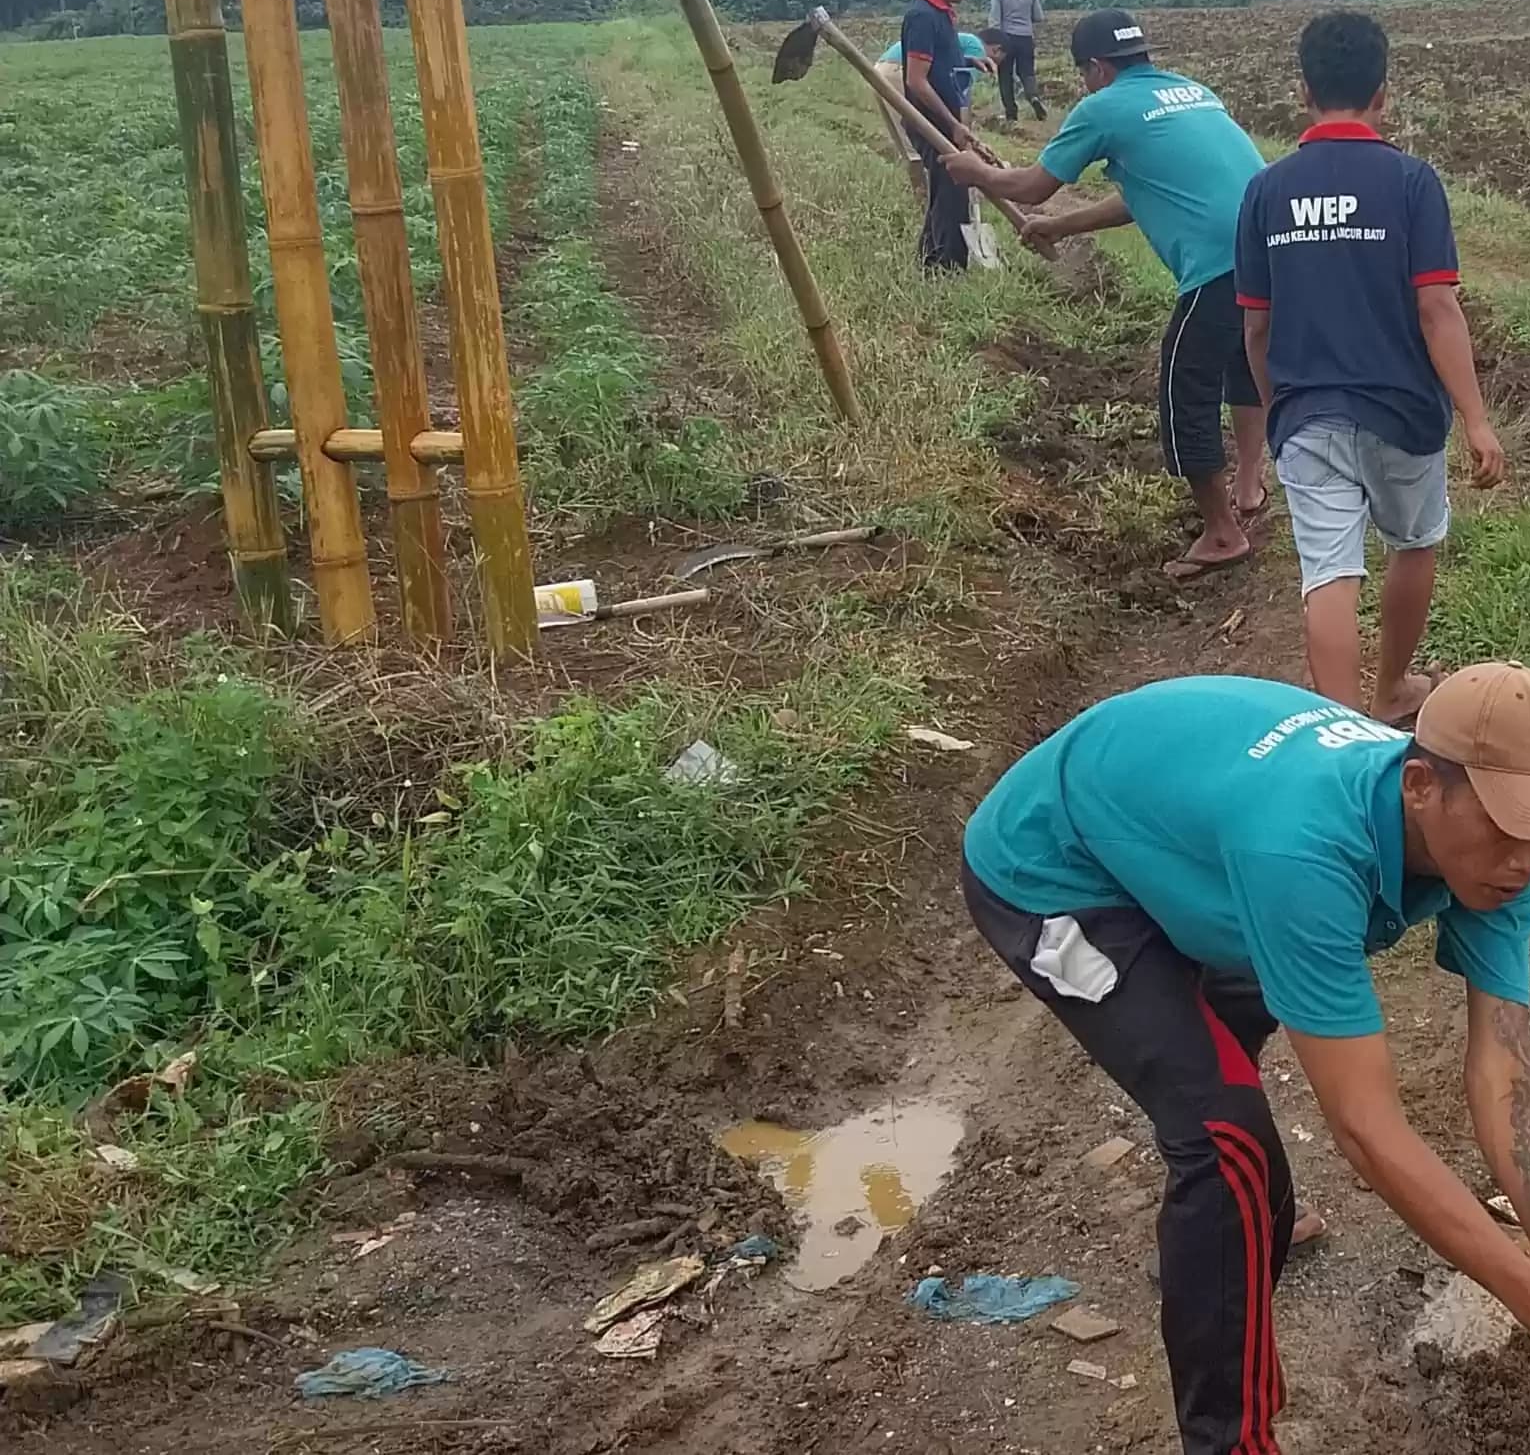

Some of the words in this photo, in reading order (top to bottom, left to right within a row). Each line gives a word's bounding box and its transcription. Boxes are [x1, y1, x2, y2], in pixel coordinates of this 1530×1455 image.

[1152, 86, 1204, 105] WBP
[1290, 195, 1358, 226] WEP
[1267, 231, 1290, 247] LAPAS
[1291, 230, 1320, 242] KELAS
[1330, 228, 1337, 242] A
[1364, 228, 1385, 241] BATU
[1247, 732, 1285, 759] BATU
